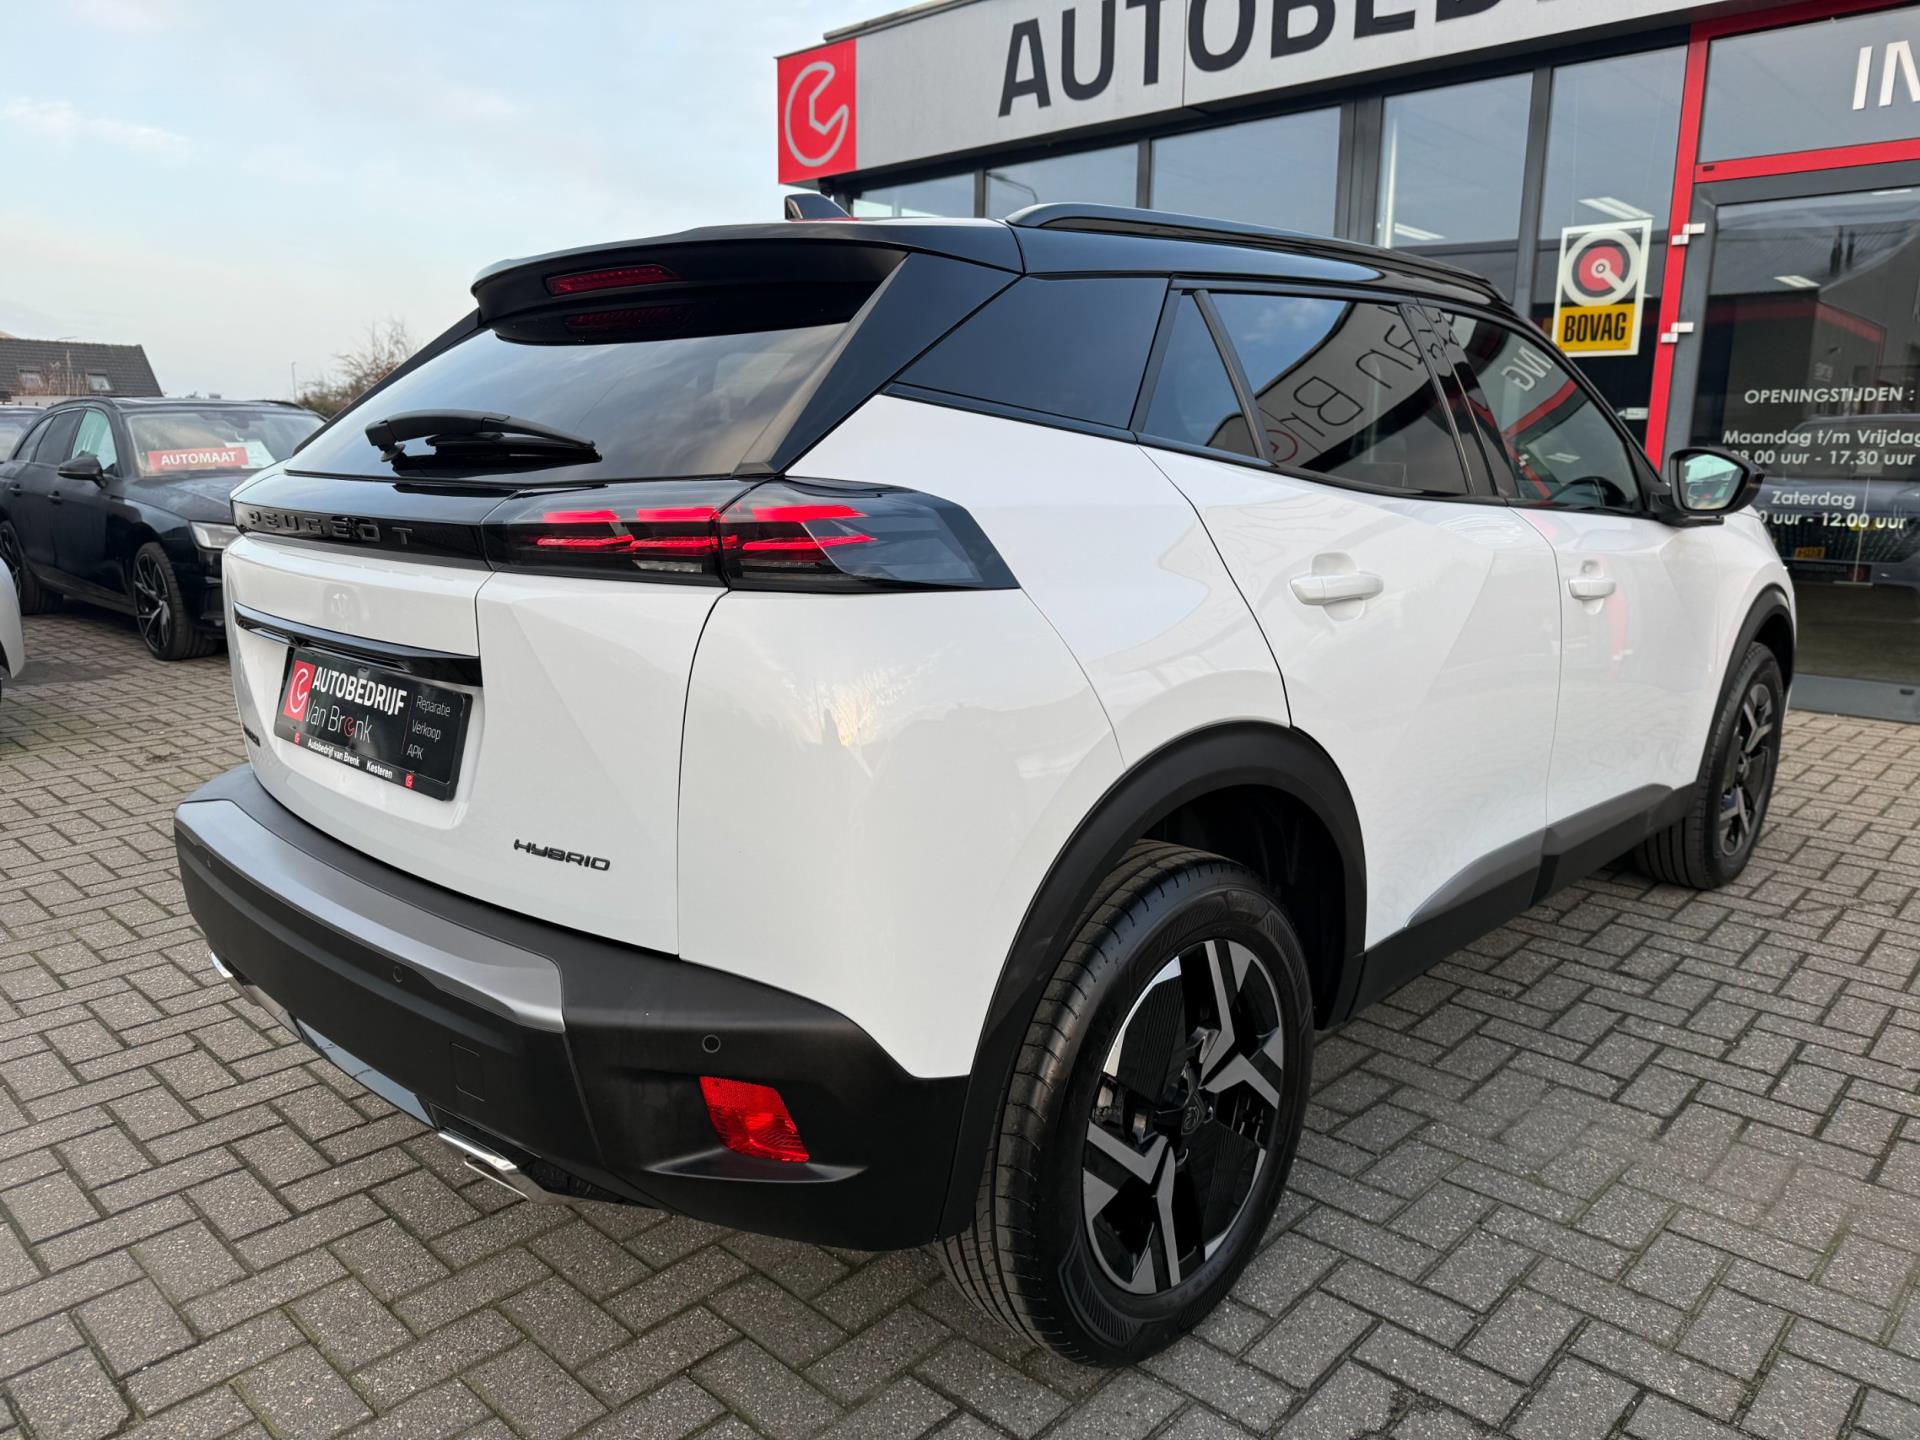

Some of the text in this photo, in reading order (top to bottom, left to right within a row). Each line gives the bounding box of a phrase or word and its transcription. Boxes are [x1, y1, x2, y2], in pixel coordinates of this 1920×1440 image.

[1563, 312, 1627, 343] BOVAG
[1744, 386, 1904, 404] OPENINGSTIJDEN
[1721, 429, 1812, 447] Maandag
[1817, 430, 1851, 446] t/m
[161, 451, 237, 466] AUTOMAAT
[1730, 450, 1776, 465] 8.00
[1780, 453, 1810, 465] uur
[1829, 450, 1878, 465] 17.30
[1884, 452, 1917, 466] uur
[1771, 490, 1856, 510] Zaterdag
[247, 510, 414, 546] PEUGEOT
[1772, 513, 1803, 525] uur
[1821, 512, 1869, 528] 12.00
[1875, 516, 1908, 530] uur
[312, 666, 408, 716] AUTOBEDRIJF
[305, 697, 327, 728] Van
[416, 694, 451, 717] Reparatie
[411, 719, 442, 743] Verkoop
[307, 738, 335, 759] Autobedrijf
[343, 751, 360, 767] Brenk
[366, 760, 393, 780] Kesteren
[406, 743, 424, 760] APK
[513, 838, 611, 871] HYBRID
